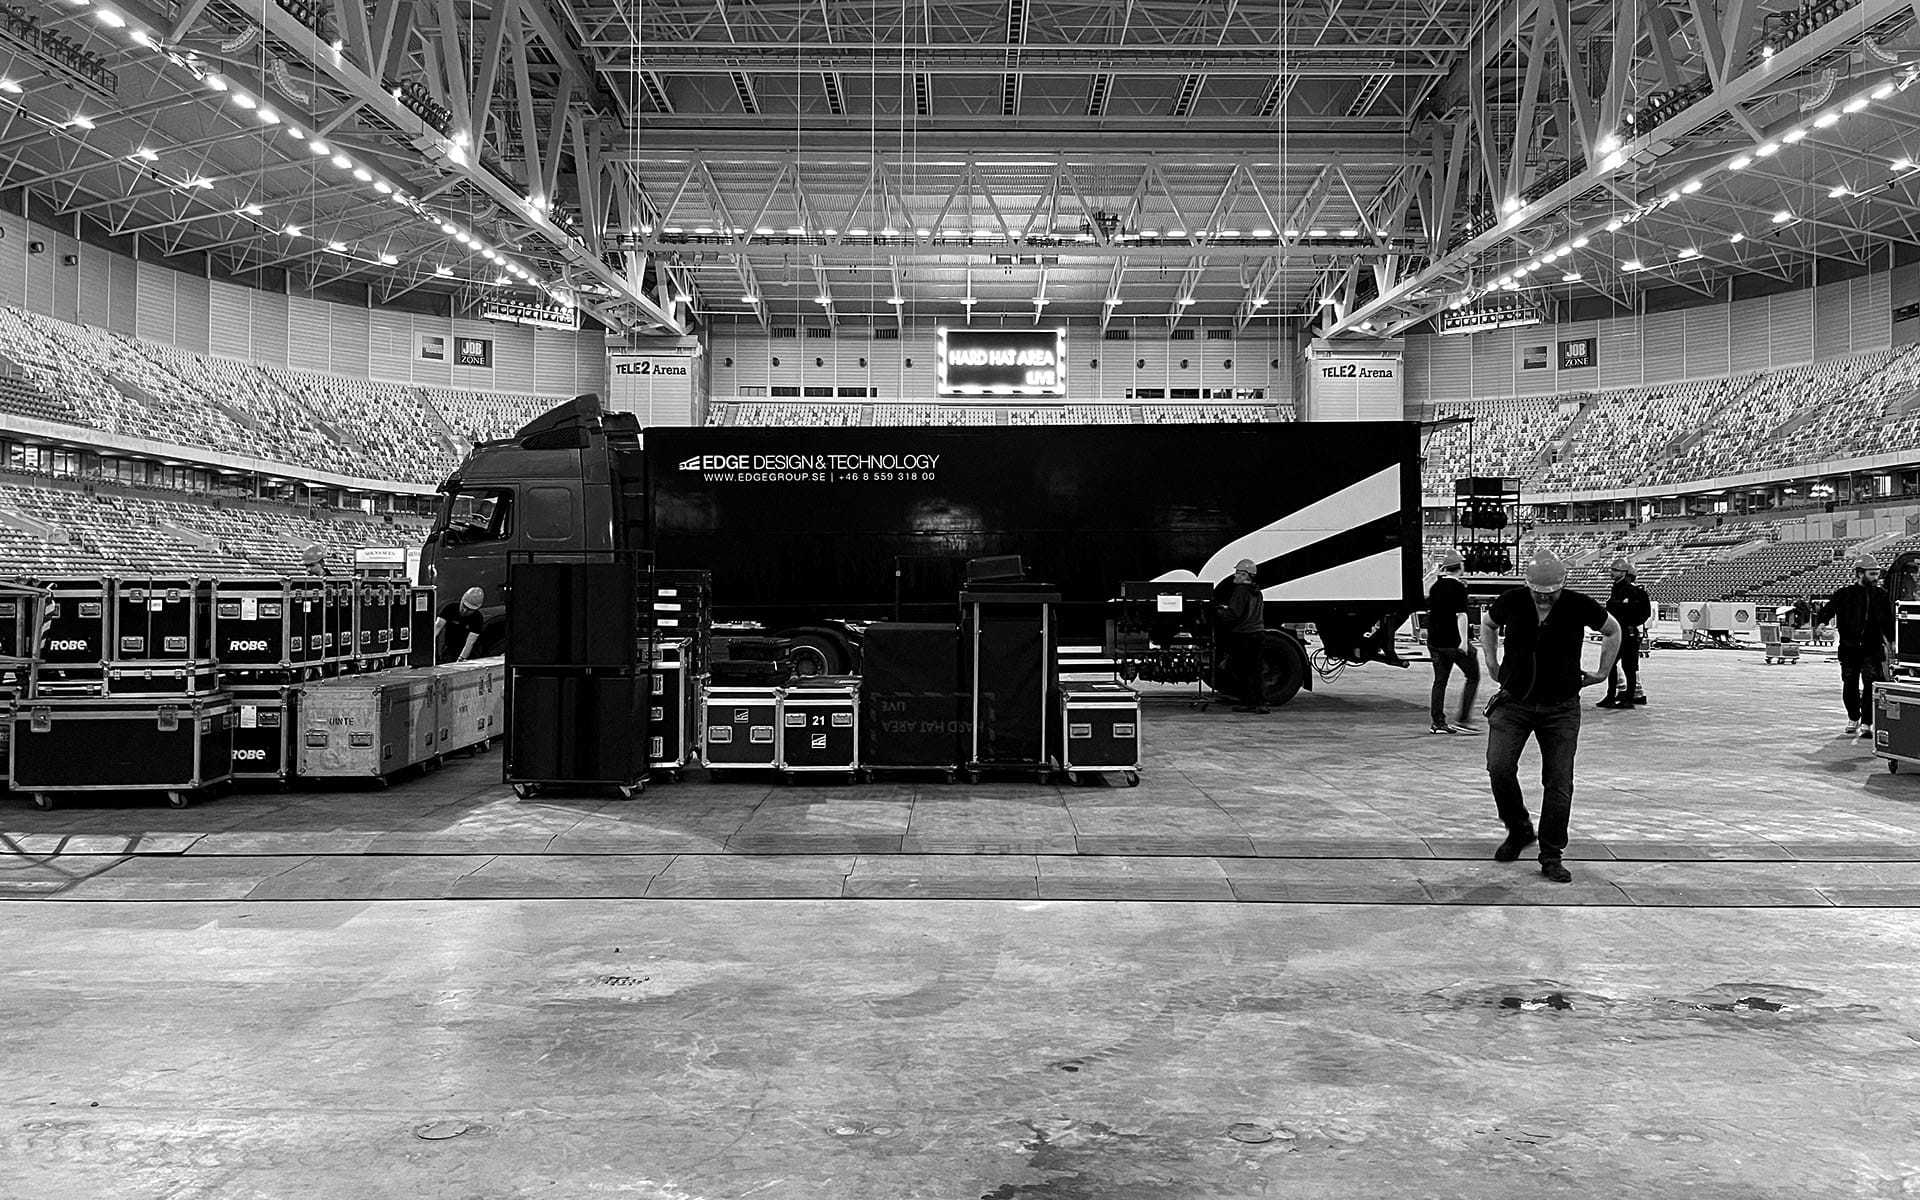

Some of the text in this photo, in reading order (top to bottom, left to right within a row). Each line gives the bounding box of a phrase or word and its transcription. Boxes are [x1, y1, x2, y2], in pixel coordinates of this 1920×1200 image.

[463, 341, 483, 355] JOB
[1566, 343, 1587, 357] JOB
[461, 355, 486, 366] ZONE
[948, 349, 1055, 366] HARD HAT AREA
[1565, 357, 1590, 367] ZONE
[615, 361, 687, 375] TELE2 Arena
[1322, 364, 1394, 378] TELE2 Arena
[1026, 370, 1056, 385] LIVE
[703, 455, 750, 470] EDGE
[704, 473, 826, 481] WWW.EDGEGROUP.SE
[839, 472, 859, 481] +46
[862, 472, 869, 481] 8
[873, 472, 894, 481] 559
[897, 472, 918, 481] 318
[921, 472, 935, 481] 00
[881, 700, 906, 712] LIVE
[812, 715, 825, 726] 21
[881, 720, 917, 733] AREA
